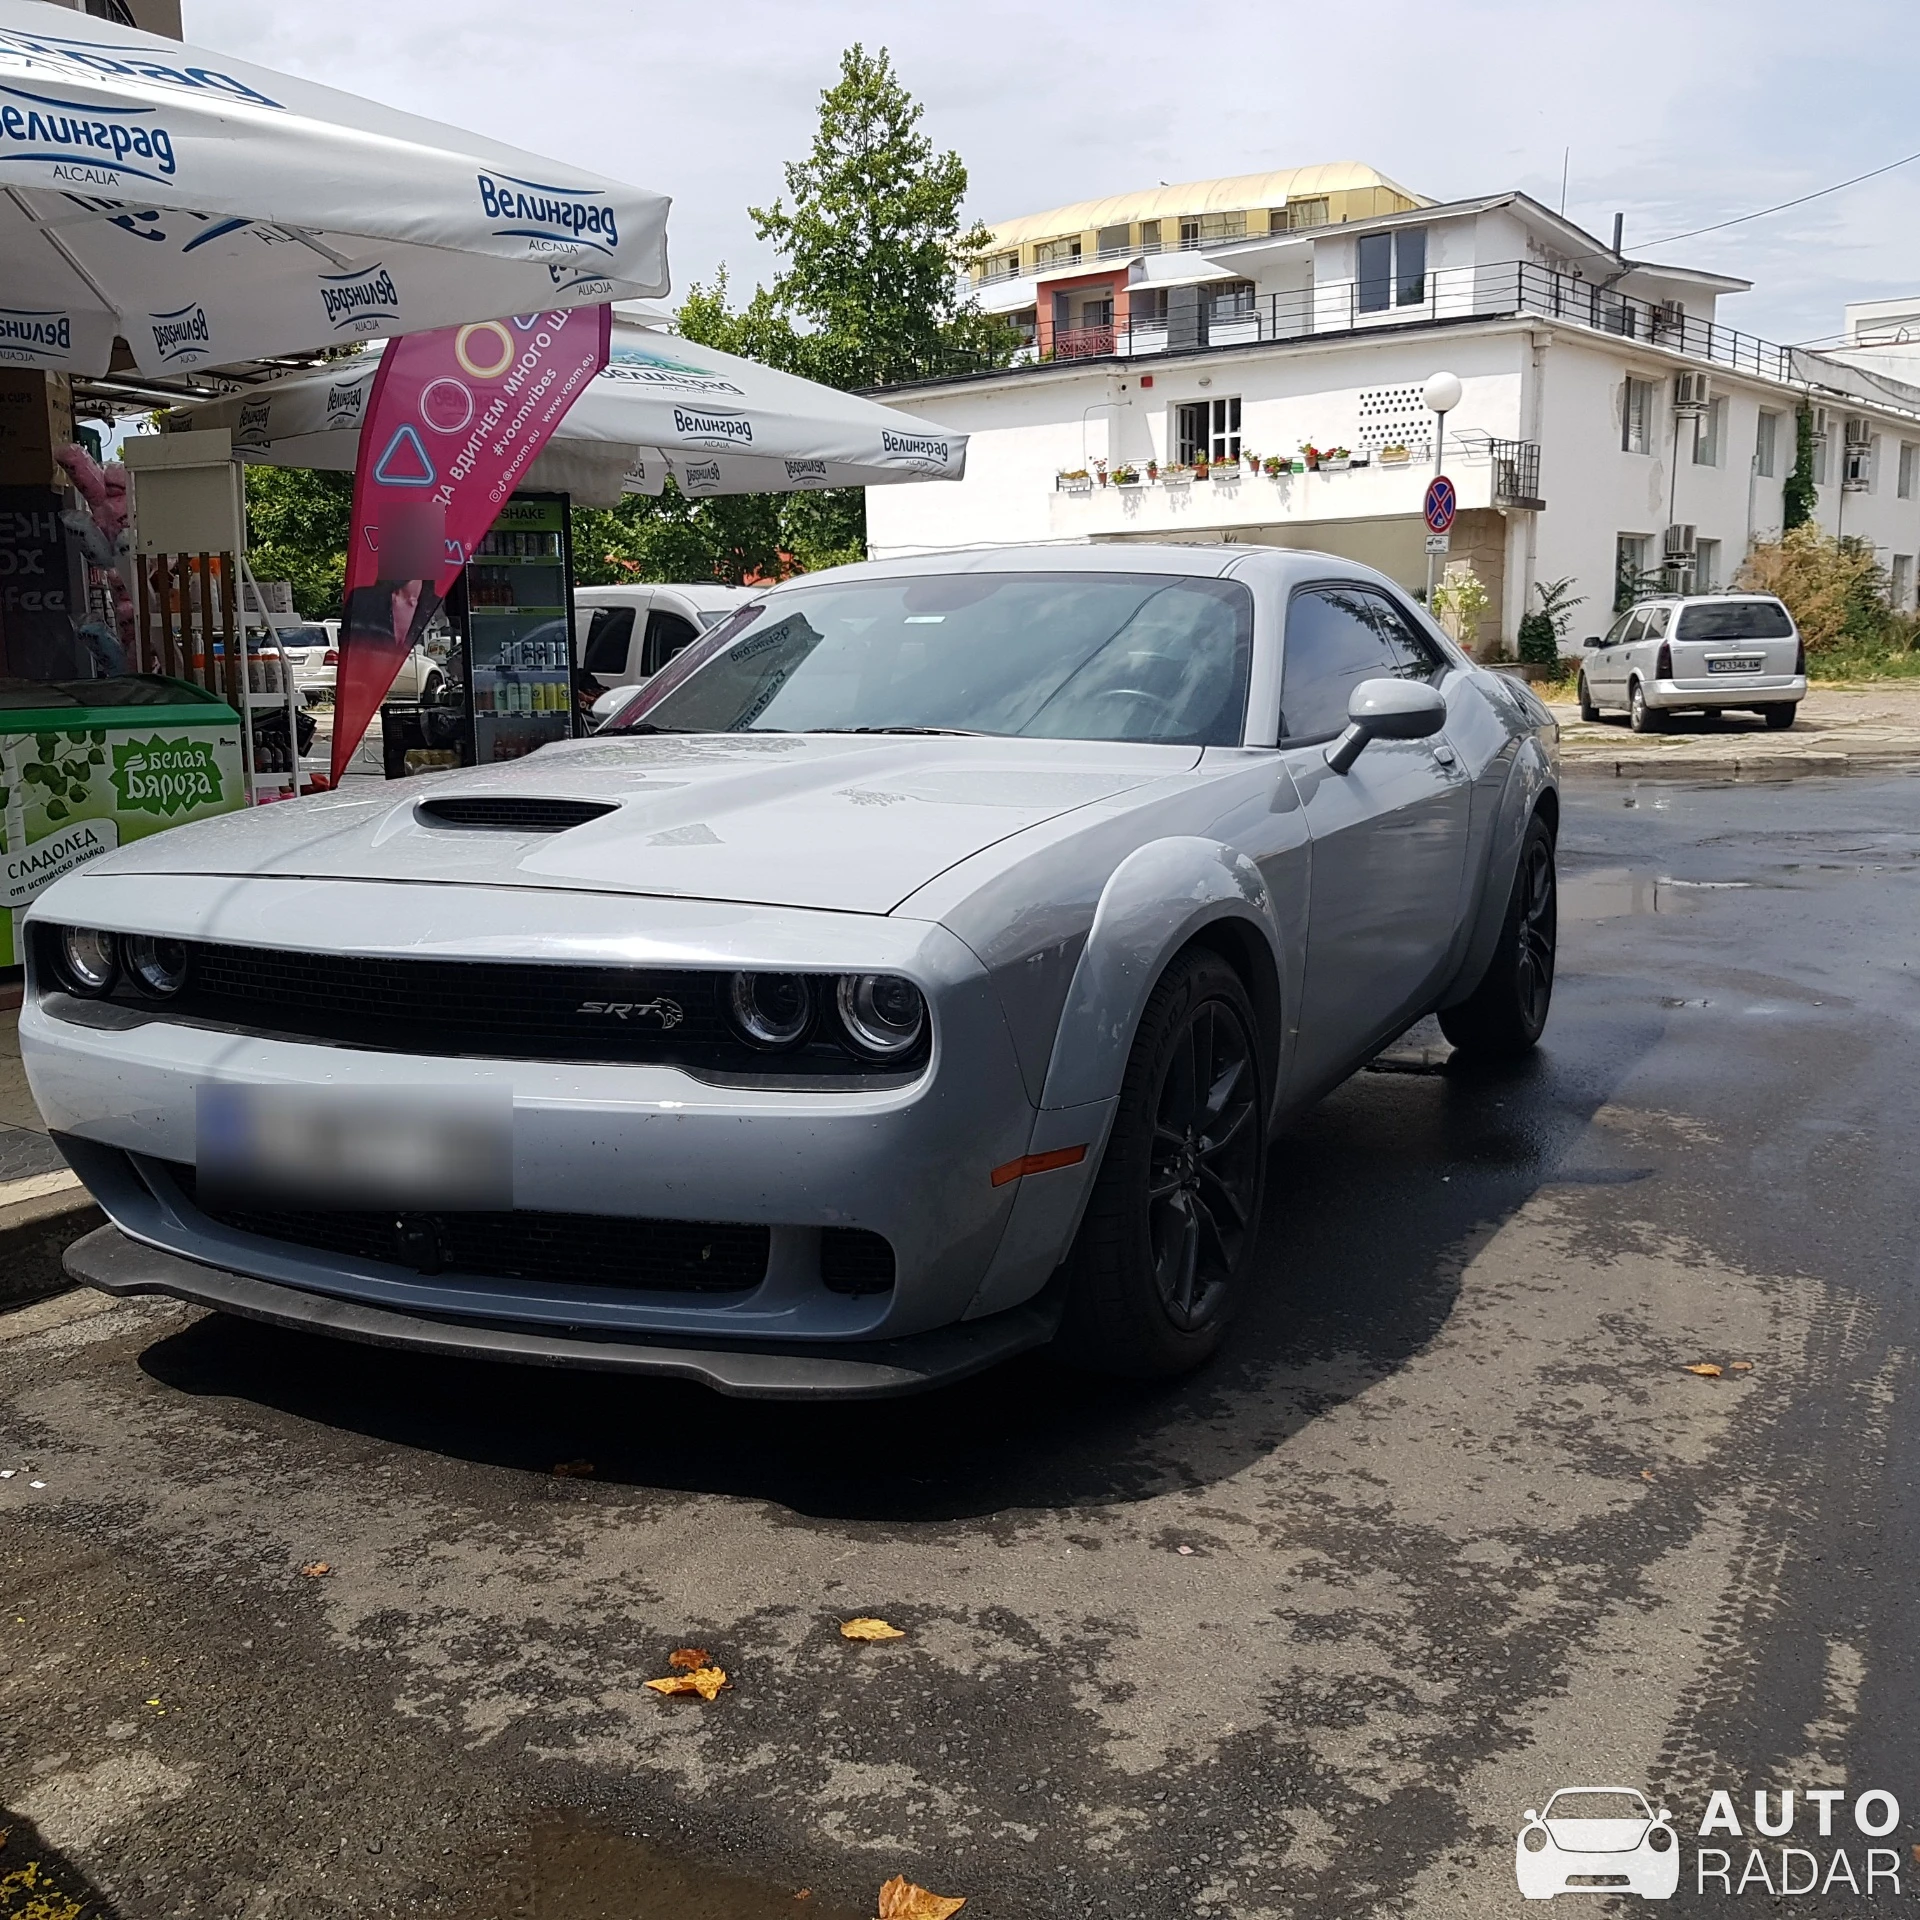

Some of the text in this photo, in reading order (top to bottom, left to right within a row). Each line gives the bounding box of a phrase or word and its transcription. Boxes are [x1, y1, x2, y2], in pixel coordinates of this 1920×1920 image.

[0, 105, 176, 175] елинград
[53, 165, 120, 187] ALCALIA
[477, 175, 618, 247] Велинград
[529, 239, 578, 255] ALCALIA
[449, 397, 508, 481] ВДИГНЕМ
[503, 332, 551, 397] МНОГО
[547, 308, 573, 331] Ш
[493, 368, 557, 457] #voomvibes
[542, 353, 595, 424] www.voom.eu
[674, 410, 753, 441] Велинград
[882, 431, 948, 463] Велинград
[500, 508, 547, 520] SHAKE
[7, 828, 98, 879] СЛАДОЛЕД
[10, 846, 105, 897] от истинско мляко
[576, 1001, 662, 1020] SRT
